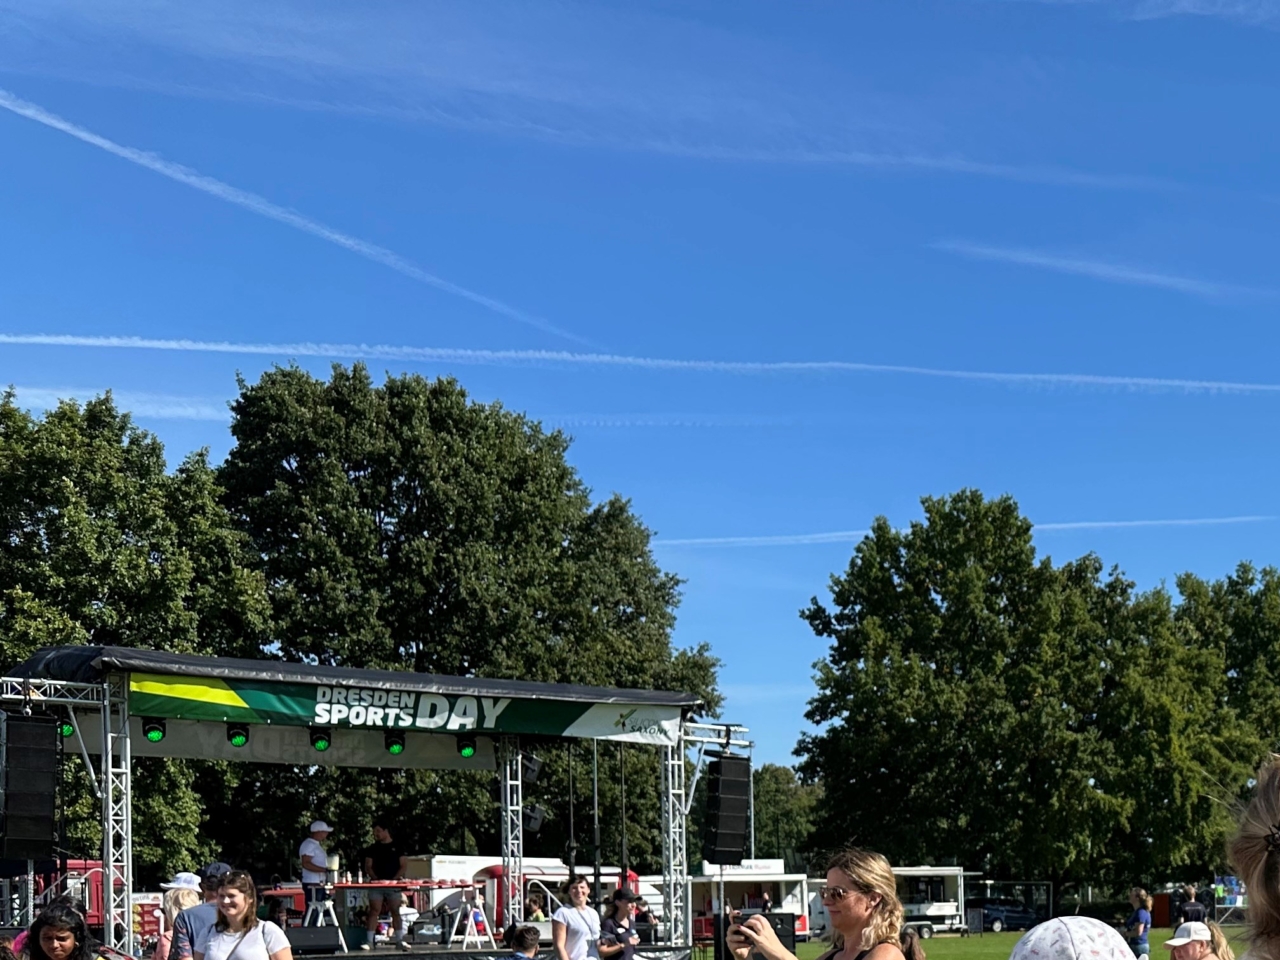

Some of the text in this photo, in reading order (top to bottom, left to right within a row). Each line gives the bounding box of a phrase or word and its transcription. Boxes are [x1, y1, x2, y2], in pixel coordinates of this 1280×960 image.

[316, 686, 415, 708] DRESDEN
[314, 703, 414, 727] SPORTS
[415, 693, 512, 730] DAY
[630, 724, 671, 737] SAXONY
